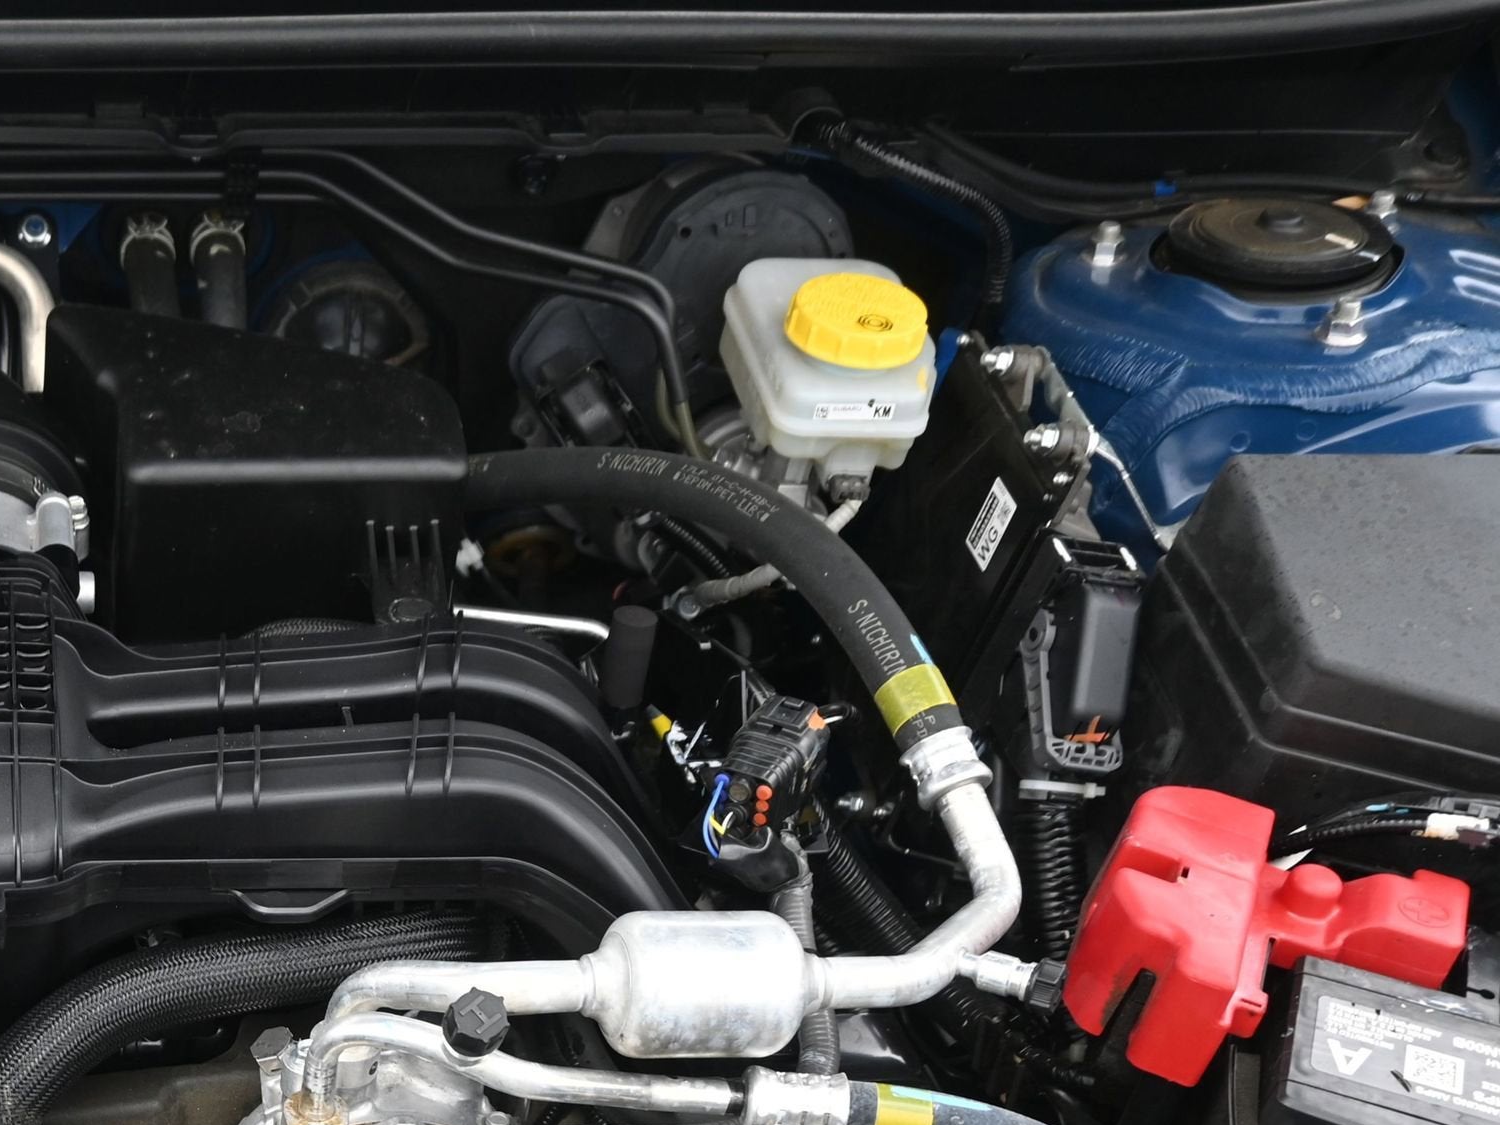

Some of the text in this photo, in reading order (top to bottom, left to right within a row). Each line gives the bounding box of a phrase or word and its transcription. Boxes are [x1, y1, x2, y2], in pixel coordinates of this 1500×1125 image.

[873, 405, 892, 418] KM
[977, 525, 999, 561] WG
[459, 994, 503, 1035] H
